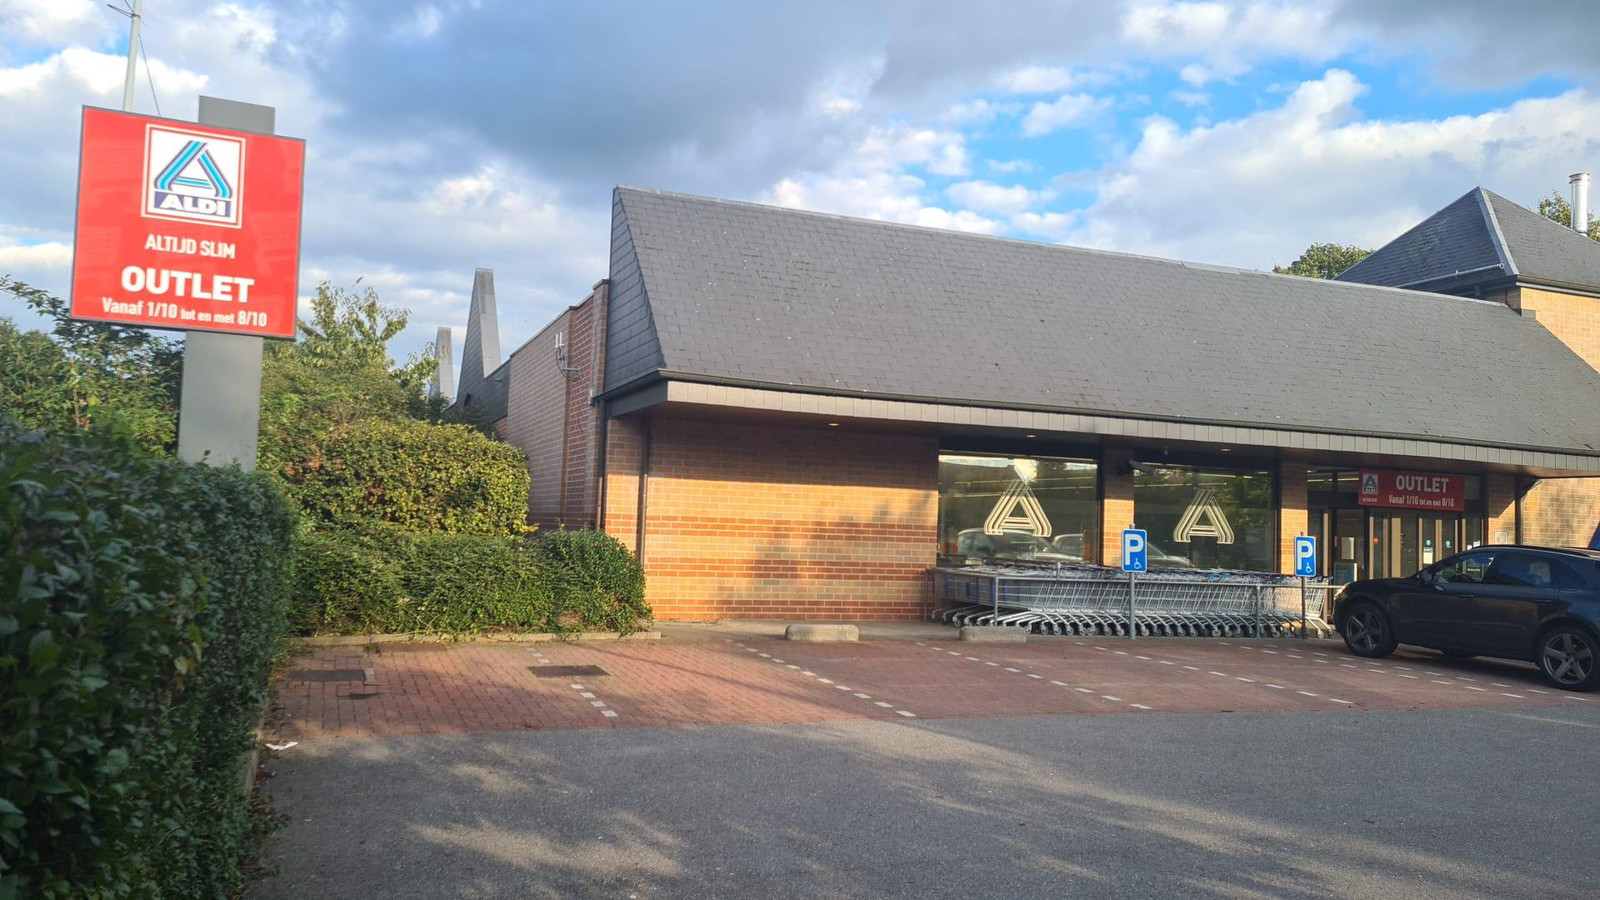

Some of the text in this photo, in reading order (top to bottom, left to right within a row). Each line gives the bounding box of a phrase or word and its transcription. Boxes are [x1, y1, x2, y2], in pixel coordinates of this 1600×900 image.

[159, 194, 227, 216] ALDI
[144, 233, 236, 259] ALTIJD SLIM
[121, 265, 255, 303] OUTLET
[102, 296, 268, 327] Vanaf 1/10 tot en met 8/10
[1396, 475, 1449, 493] OUTLET
[1388, 494, 1405, 504] Vanaf
[1406, 495, 1418, 505] 1/10
[1125, 533, 1144, 565] P
[1297, 540, 1313, 570] P
